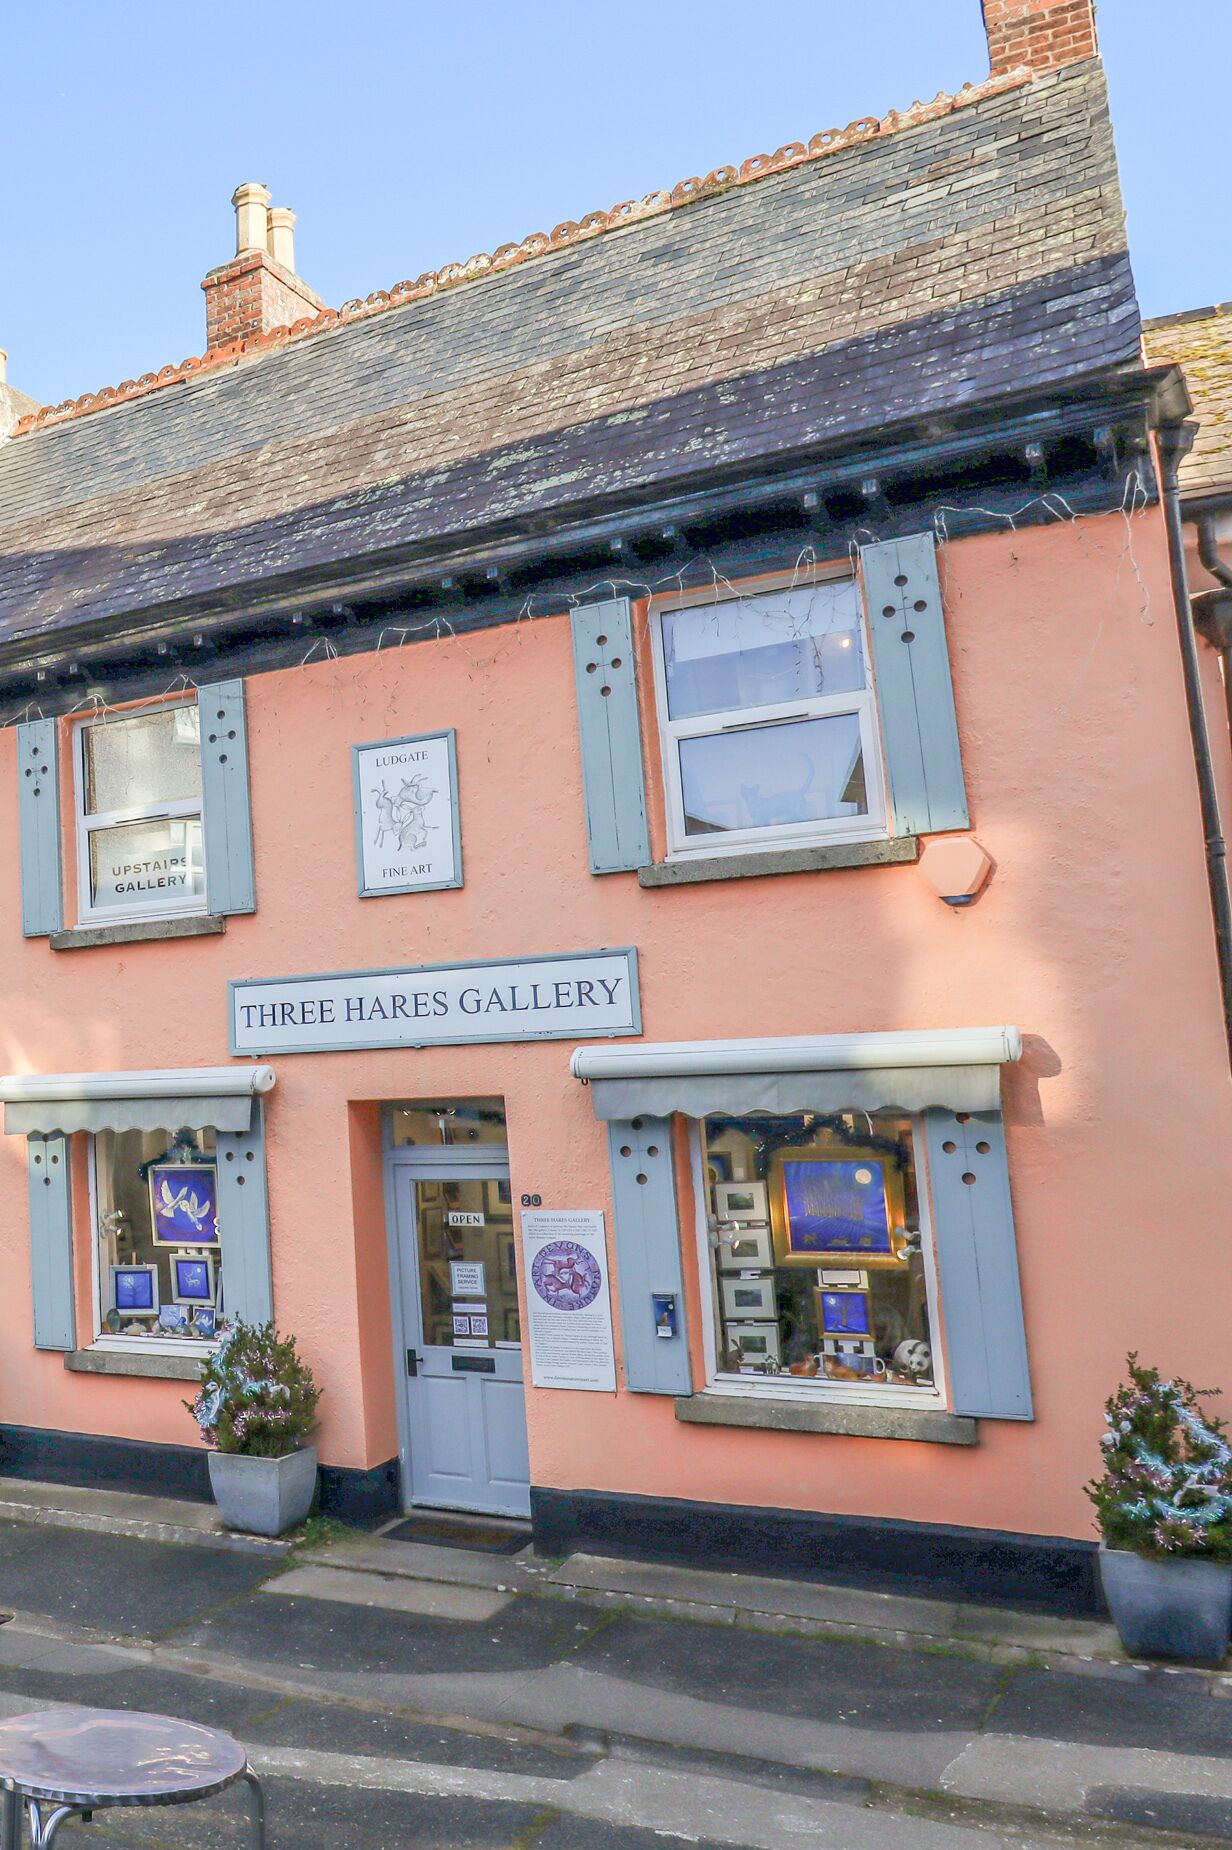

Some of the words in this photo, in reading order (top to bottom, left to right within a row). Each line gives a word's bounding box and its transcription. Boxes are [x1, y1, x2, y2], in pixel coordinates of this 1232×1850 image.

[375, 750, 429, 768] LUDGATE
[112, 856, 187, 877] UPSTAIRS
[382, 866, 408, 879] FINE
[410, 863, 433, 876] ART
[115, 874, 187, 894] GALLERY
[239, 998, 337, 1029] THREE
[343, 990, 449, 1023] HARES
[458, 977, 624, 1016] GALLERY
[522, 1195, 541, 1206] 20
[452, 1214, 481, 1224] OPEN
